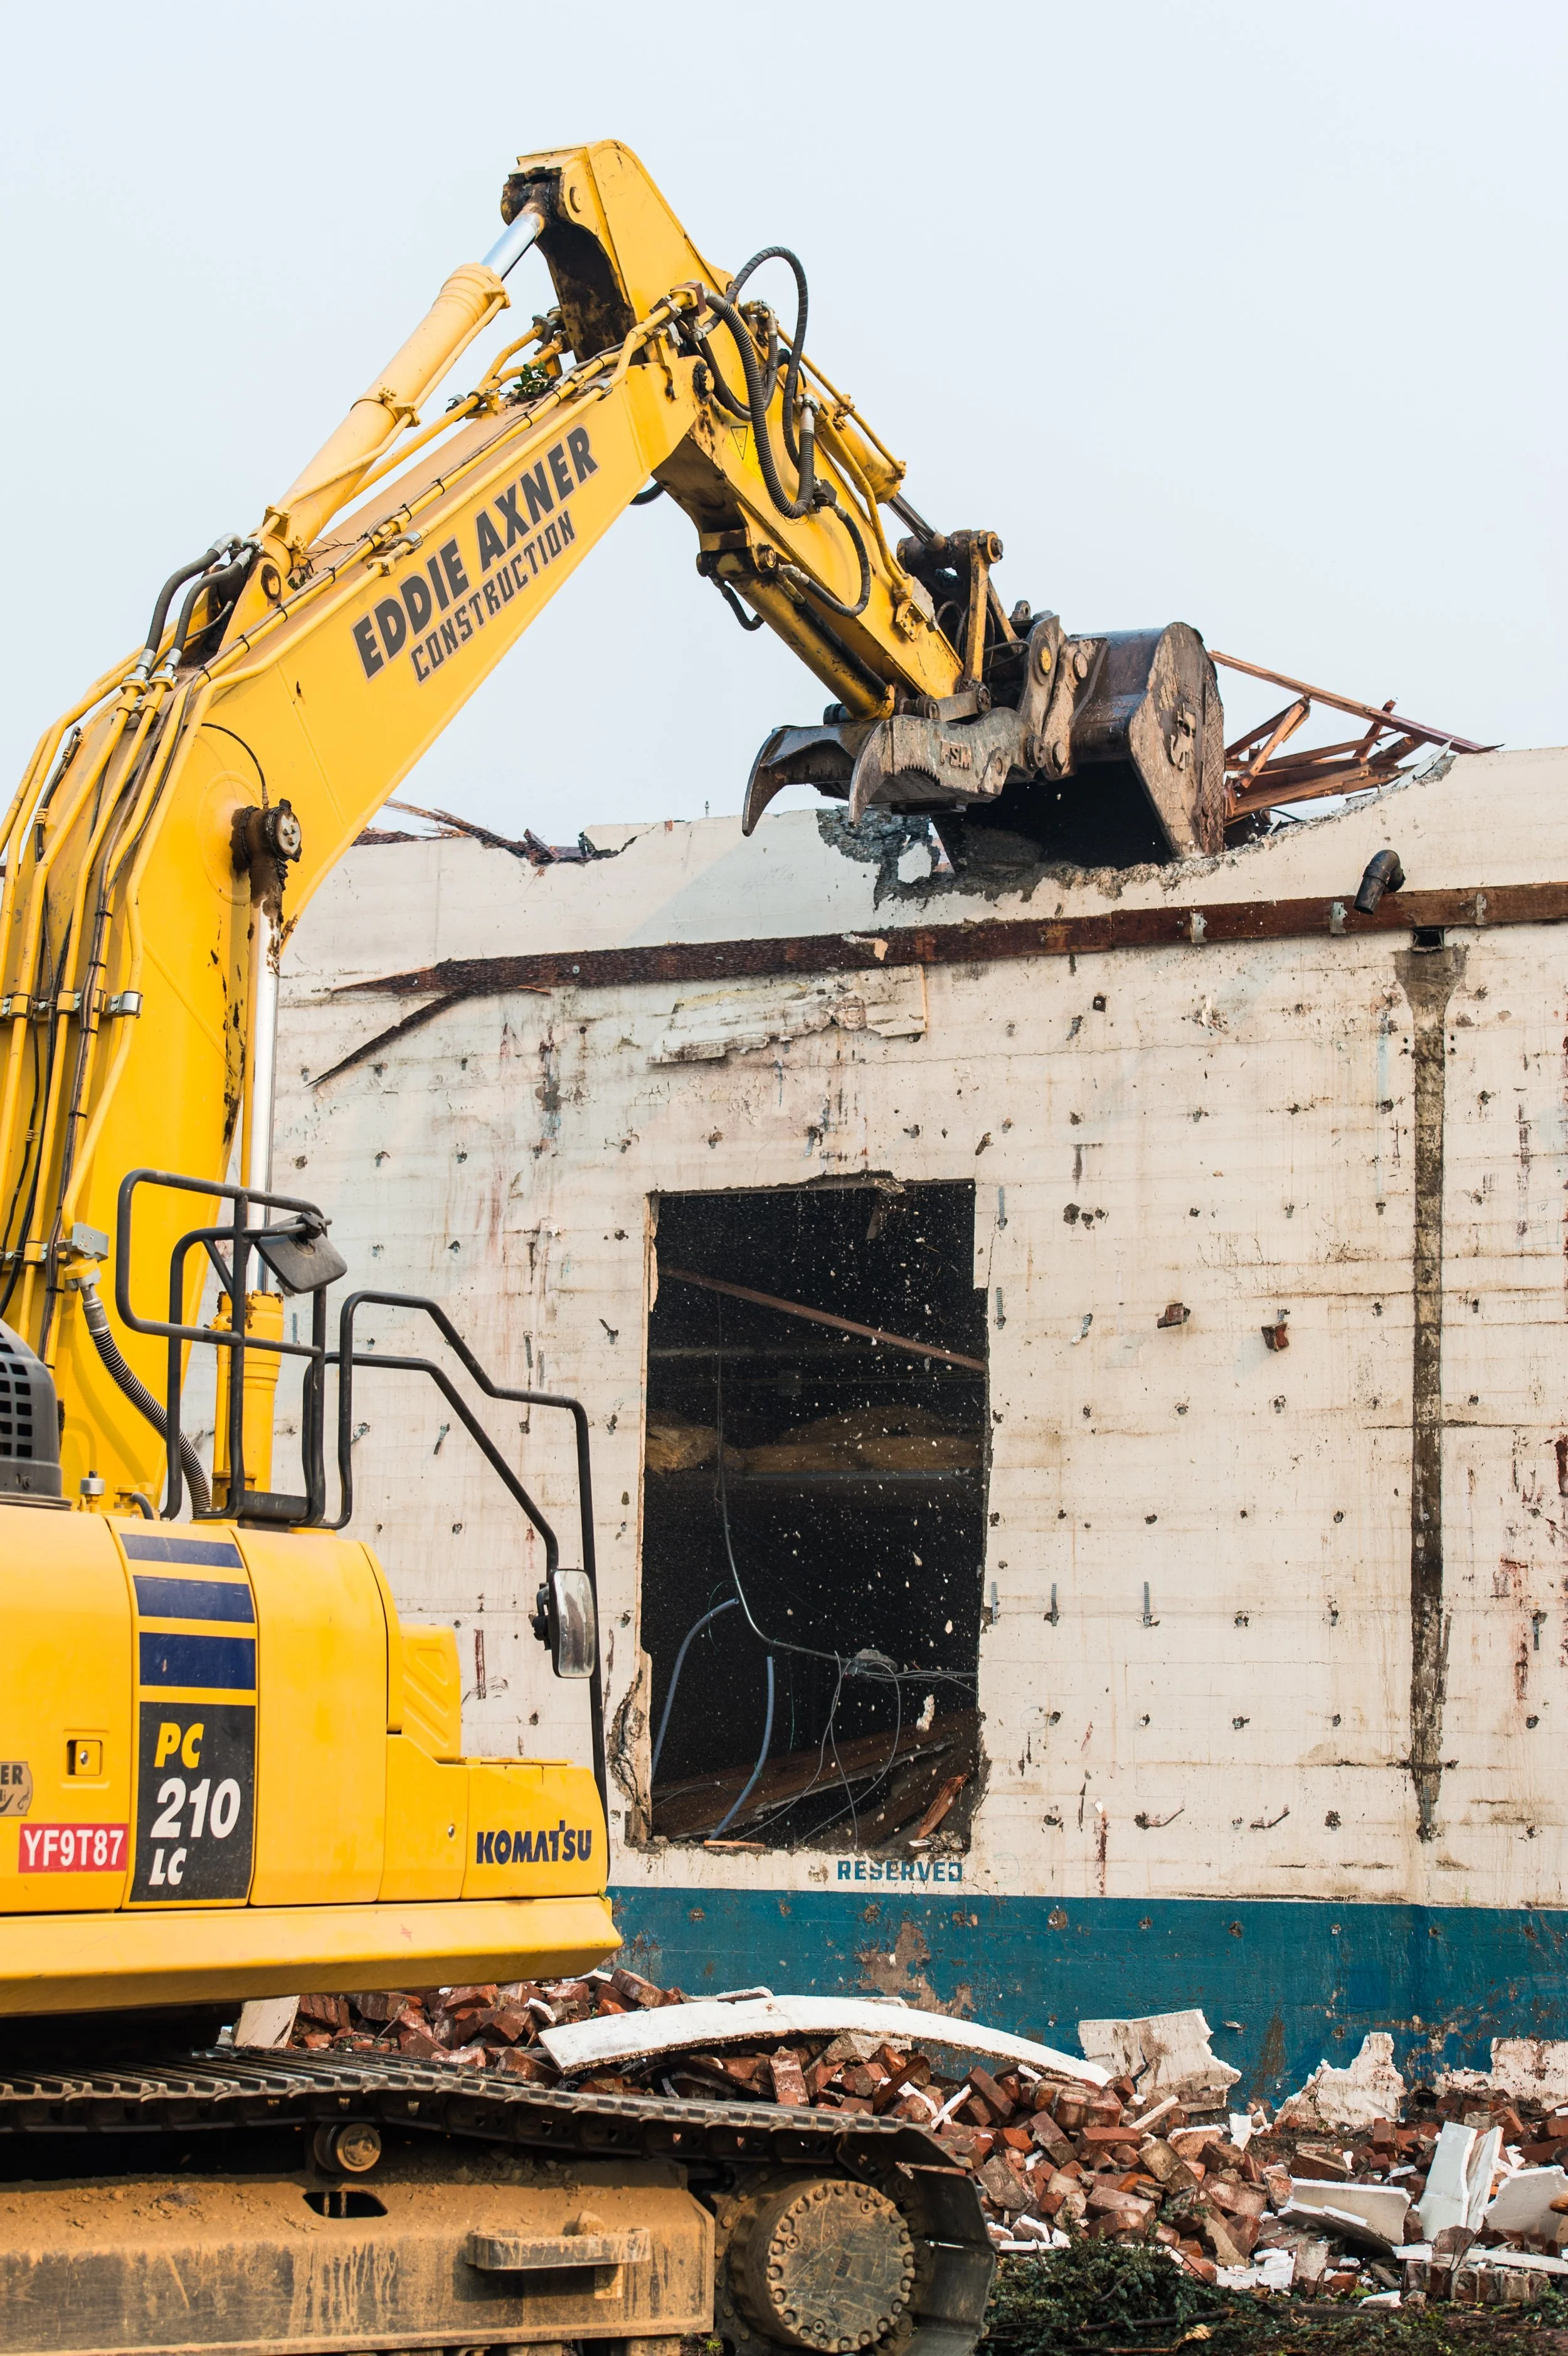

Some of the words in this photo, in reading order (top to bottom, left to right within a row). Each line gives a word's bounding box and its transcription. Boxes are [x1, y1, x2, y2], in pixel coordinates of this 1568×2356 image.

[352, 539, 469, 679] EDDIE
[475, 427, 598, 573] AXNER
[411, 510, 576, 682] CONSTRUCTION
[154, 1722, 204, 1768] PC
[151, 1777, 241, 1839] 210
[24, 1829, 124, 1867] YF9T87
[476, 1820, 591, 1865] KOMATSU
[149, 1848, 187, 1886] LC
[837, 1860, 963, 1882] RESERVED
